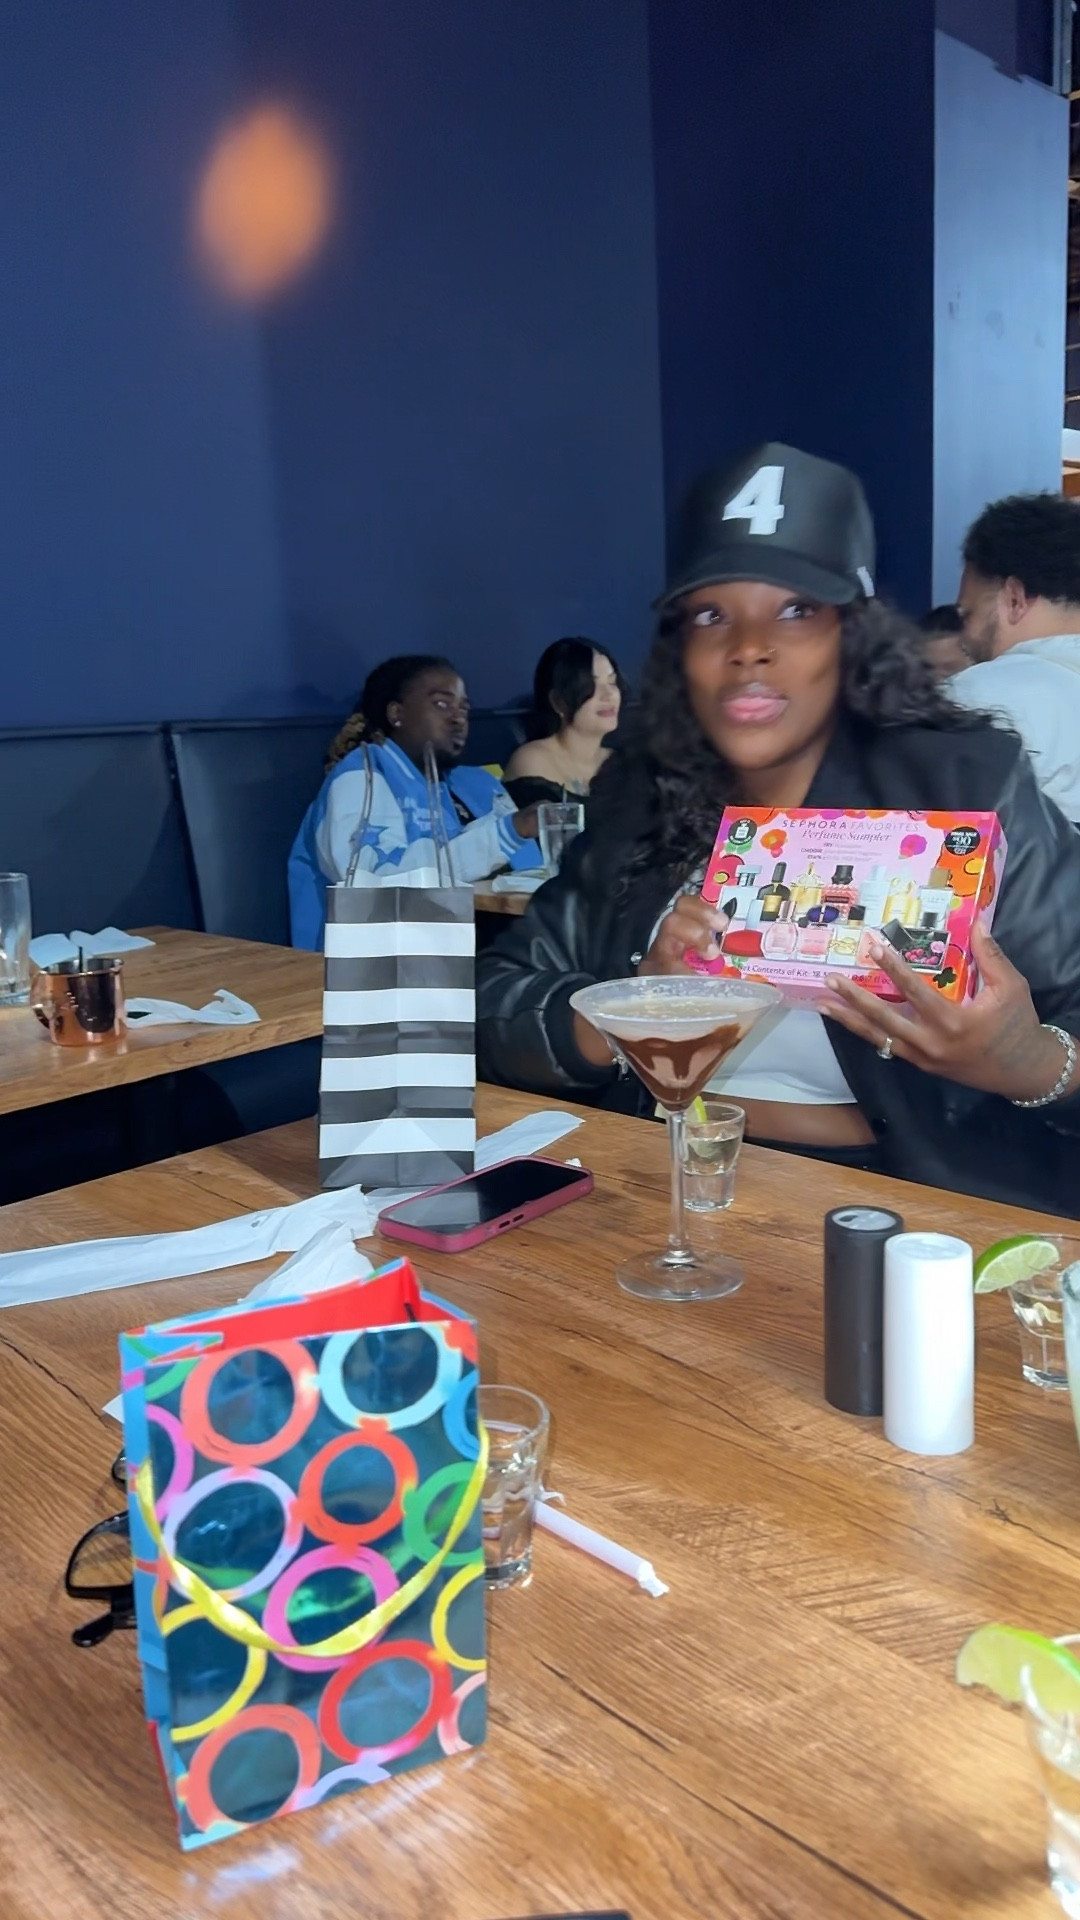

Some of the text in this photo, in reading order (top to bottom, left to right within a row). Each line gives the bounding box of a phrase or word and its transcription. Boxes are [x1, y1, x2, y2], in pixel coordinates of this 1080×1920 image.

[722, 465, 785, 535] 4
[782, 820, 920, 832] SEPHORA FAVORITES
[802, 829, 892, 843] Perfume Sampler
[752, 964, 785, 975] Contents
